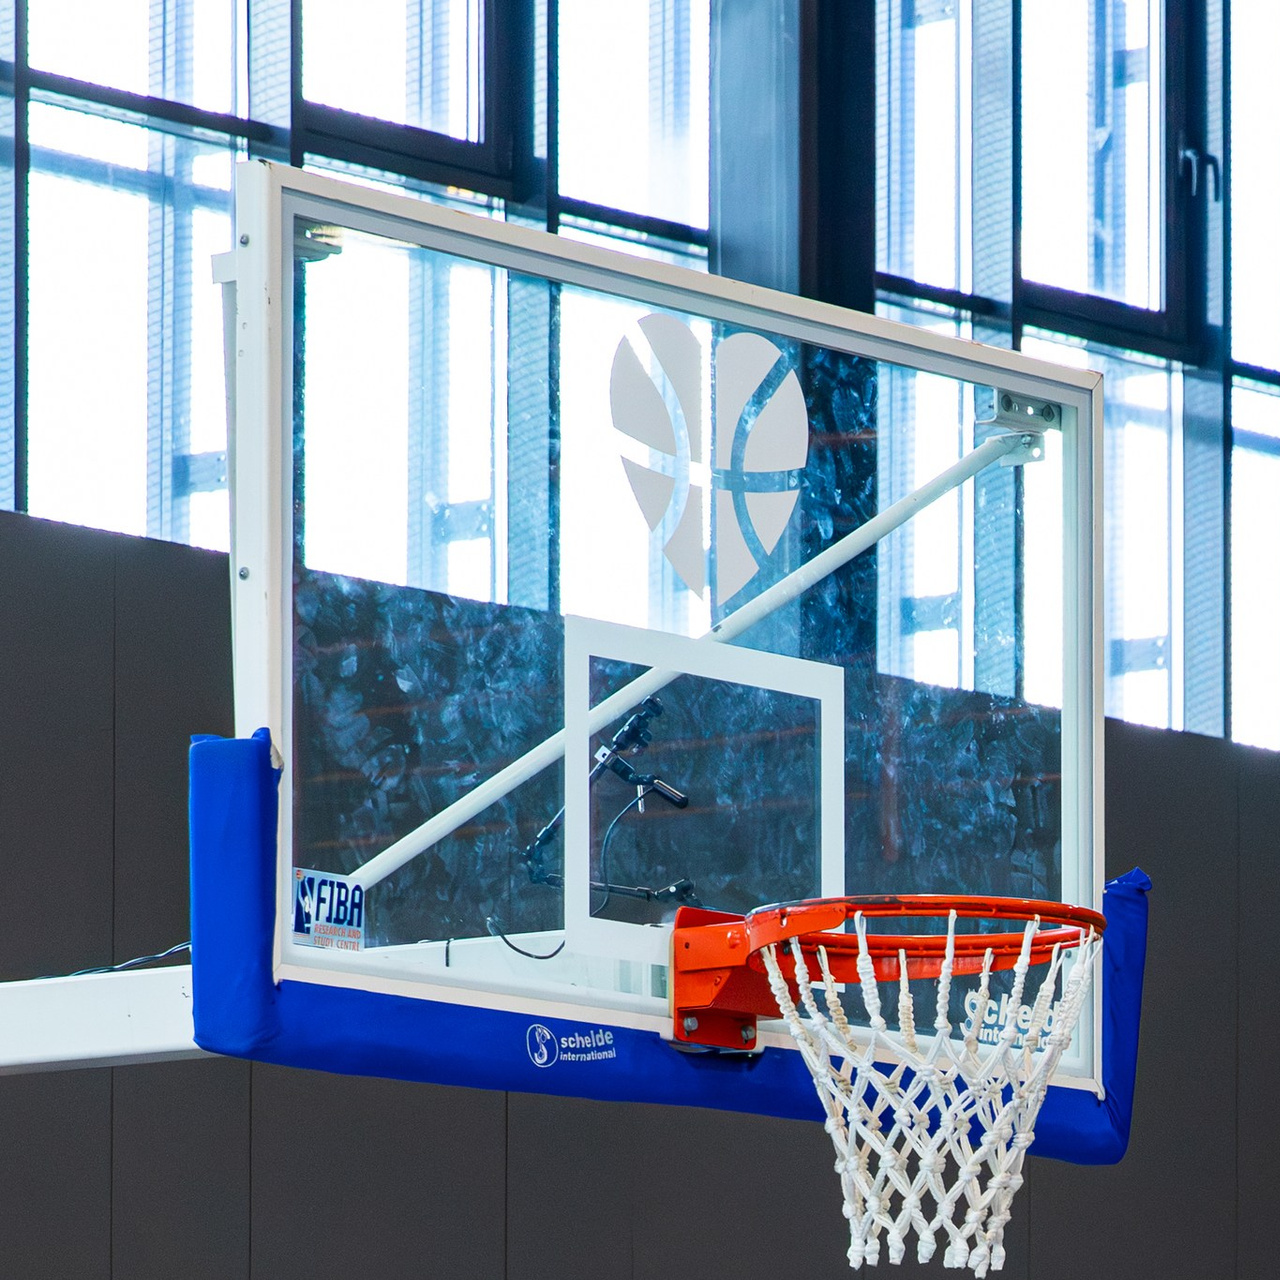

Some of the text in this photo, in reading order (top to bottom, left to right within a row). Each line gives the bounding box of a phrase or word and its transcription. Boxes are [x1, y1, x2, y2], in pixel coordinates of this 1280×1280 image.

[315, 878, 364, 928] FIBA
[314, 923, 361, 940] RESEARCH AND
[313, 936, 360, 952] STUDY CENTRE
[560, 1028, 614, 1049] schelde
[559, 1047, 616, 1062] international
